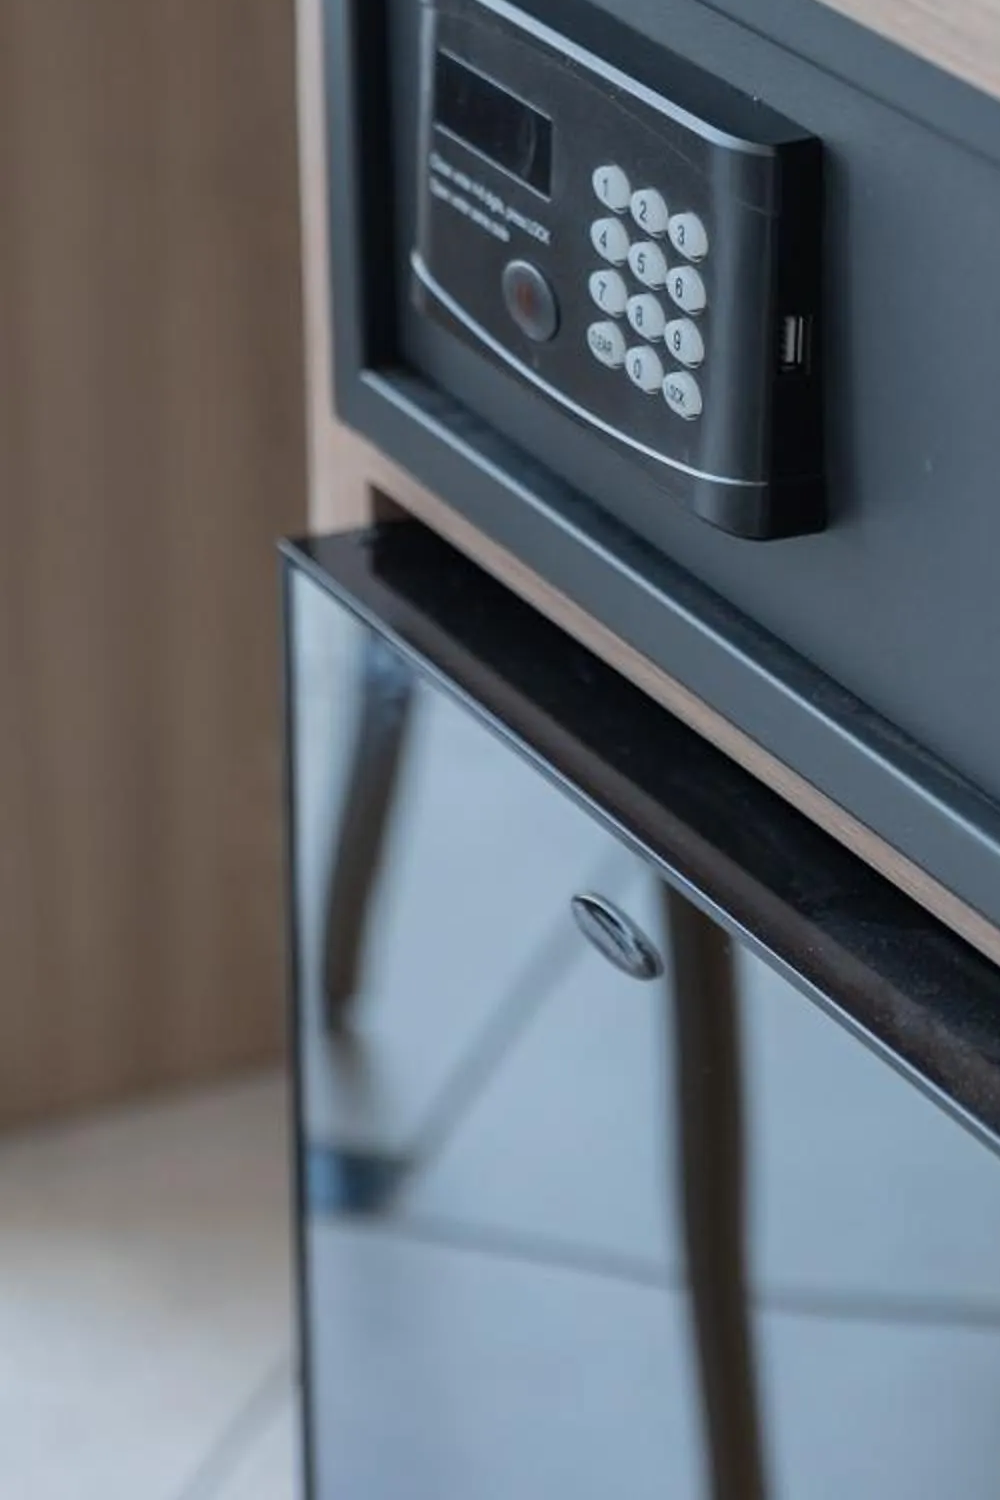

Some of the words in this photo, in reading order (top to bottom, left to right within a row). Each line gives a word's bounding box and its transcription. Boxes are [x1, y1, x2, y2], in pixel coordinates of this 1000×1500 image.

[639, 200, 649, 223] 2
[677, 223, 686, 247] 3
[599, 226, 608, 250] 4
[637, 252, 647, 275] 5
[675, 276, 684, 299] 6
[598, 279, 607, 302] 7
[635, 304, 644, 328] 8
[673, 329, 682, 353] 9
